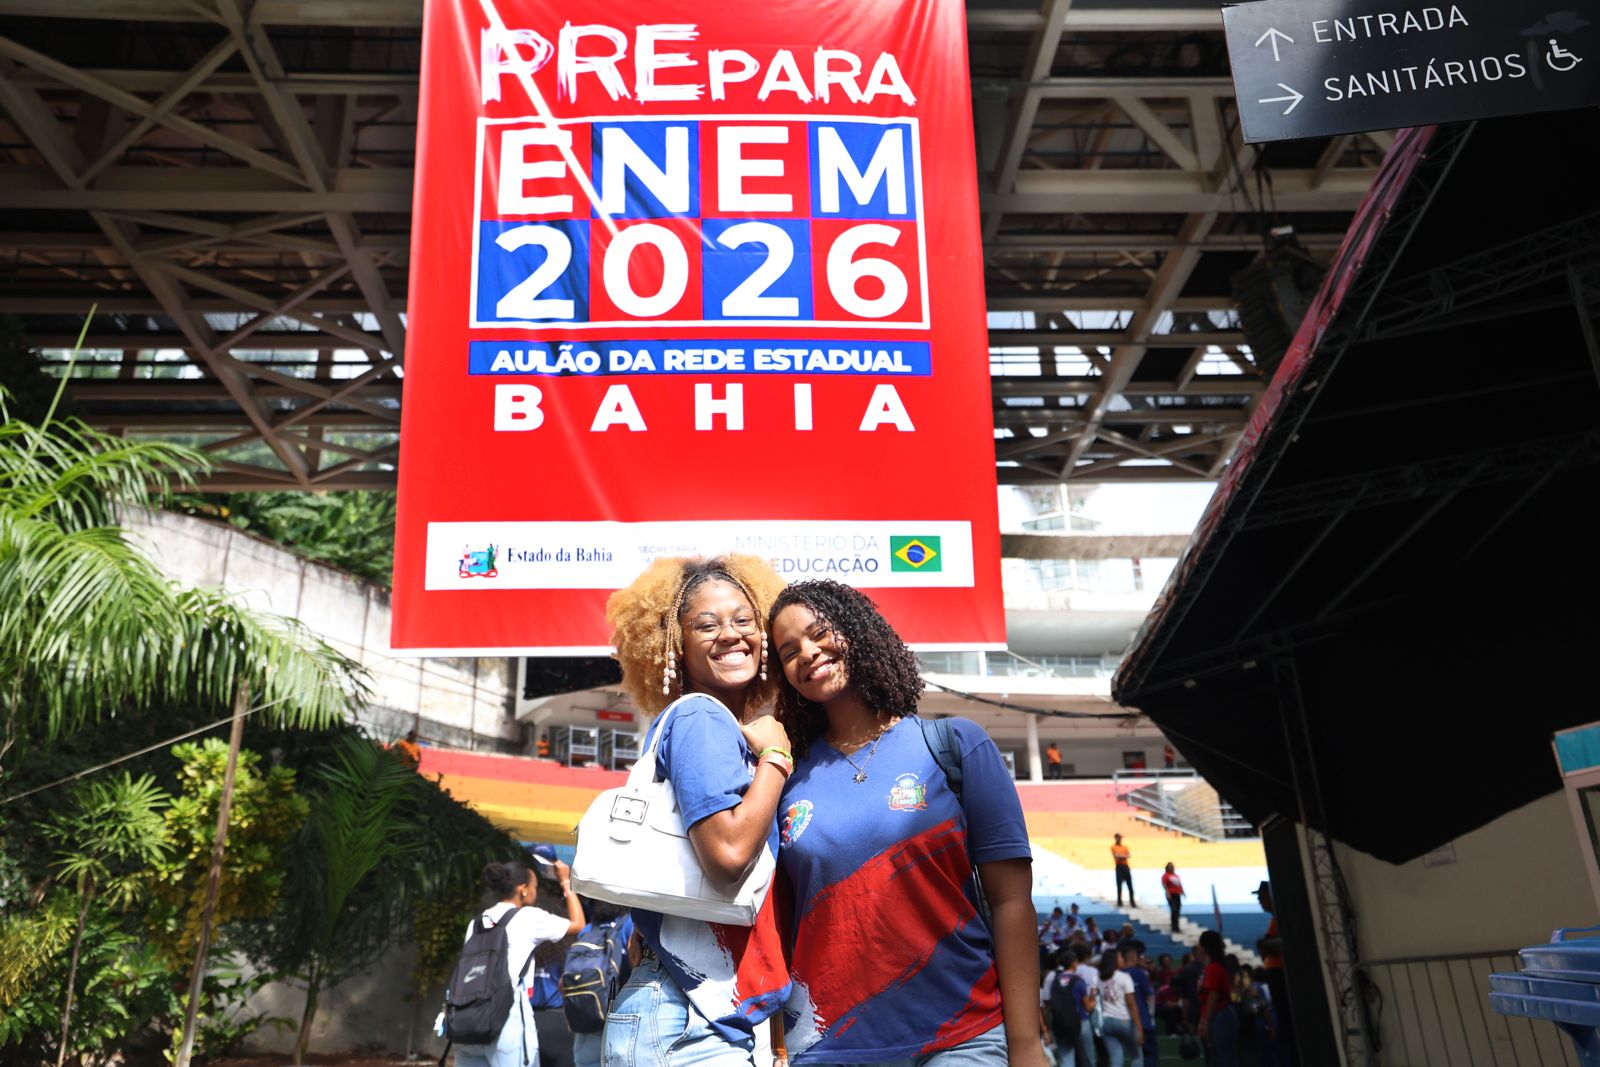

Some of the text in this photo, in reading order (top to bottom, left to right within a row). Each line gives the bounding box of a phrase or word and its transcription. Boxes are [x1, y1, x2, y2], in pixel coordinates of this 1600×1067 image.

[1311, 5, 1469, 43] ENTRADA
[480, 20, 917, 105] PREPARA
[1324, 53, 1526, 101] SANITÁRIOS
[497, 126, 908, 215] ENEM
[494, 222, 909, 319] 2026
[490, 344, 912, 374] AULÃO DA REDE ESTADUAL
[494, 383, 916, 432] BAHIA
[508, 547, 613, 563] Estado da Bahia
[852, 535, 879, 551] DA
[772, 554, 879, 577] EDUCAÇÃO
